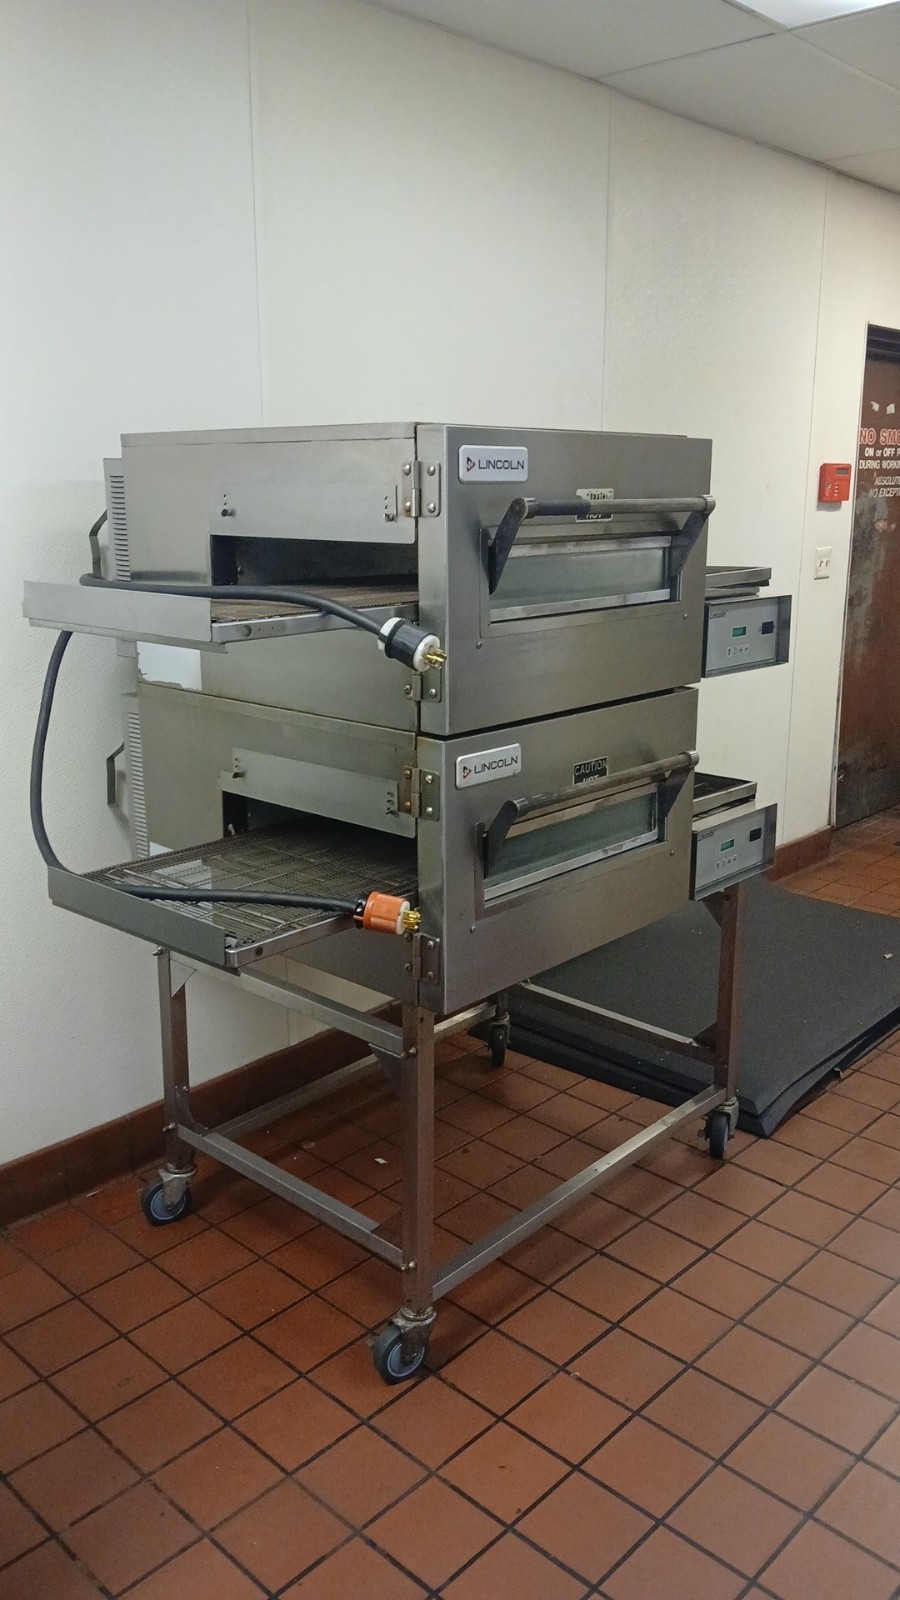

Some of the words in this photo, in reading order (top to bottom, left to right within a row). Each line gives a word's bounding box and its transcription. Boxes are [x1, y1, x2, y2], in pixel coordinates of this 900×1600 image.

[859, 427, 876, 445] NO
[865, 447, 874, 457] ON
[883, 447, 895, 457] OFF
[478, 459, 525, 470] LINCOLN
[859, 459, 880, 469] DURING
[474, 756, 518, 774] LINCOLN
[574, 760, 608, 776] CAUTION
